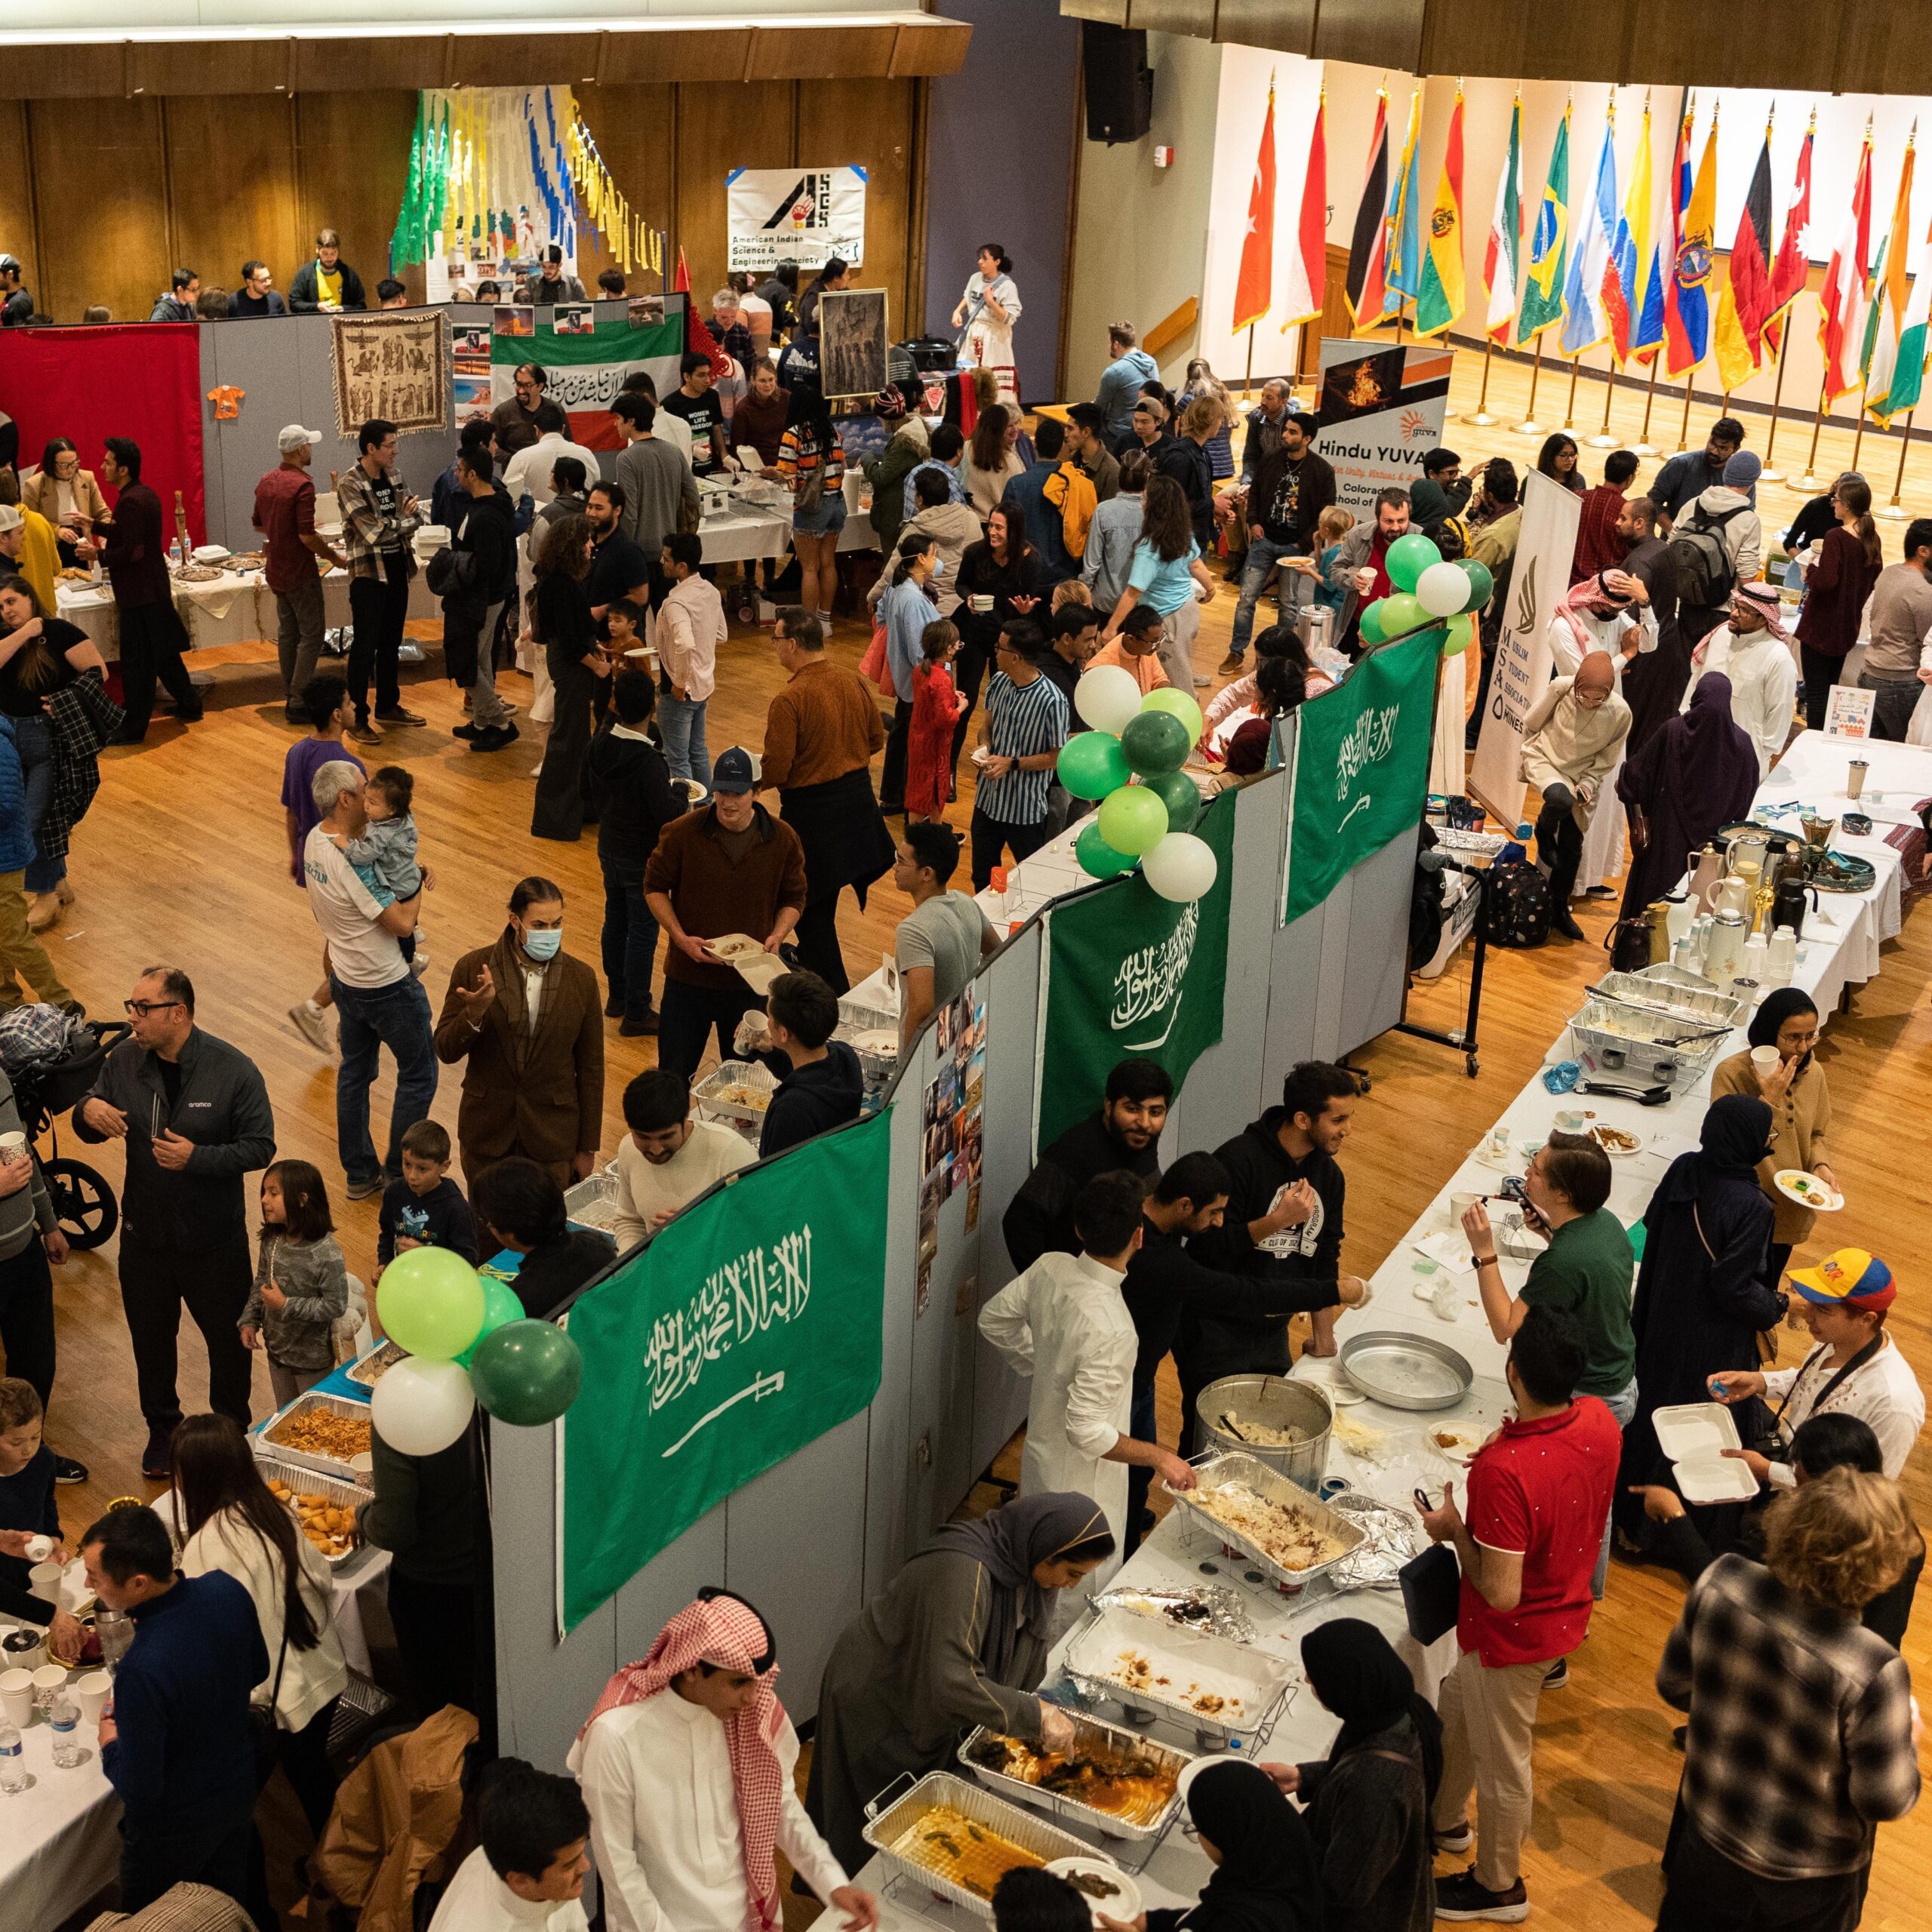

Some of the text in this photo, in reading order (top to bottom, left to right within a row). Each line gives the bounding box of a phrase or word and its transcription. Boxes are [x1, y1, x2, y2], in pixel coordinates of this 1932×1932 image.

[793, 257, 819, 265] ociety
[688, 410, 709, 419] WOMEN
[691, 422, 713, 430] REEDOM
[1318, 440, 1426, 465] Hindu YUVA
[1343, 483, 1385, 495] Colorad
[1361, 498, 1374, 507] of
[1503, 708, 1524, 734] MINES
[1304, 1204, 1320, 1237] PROGRAM
